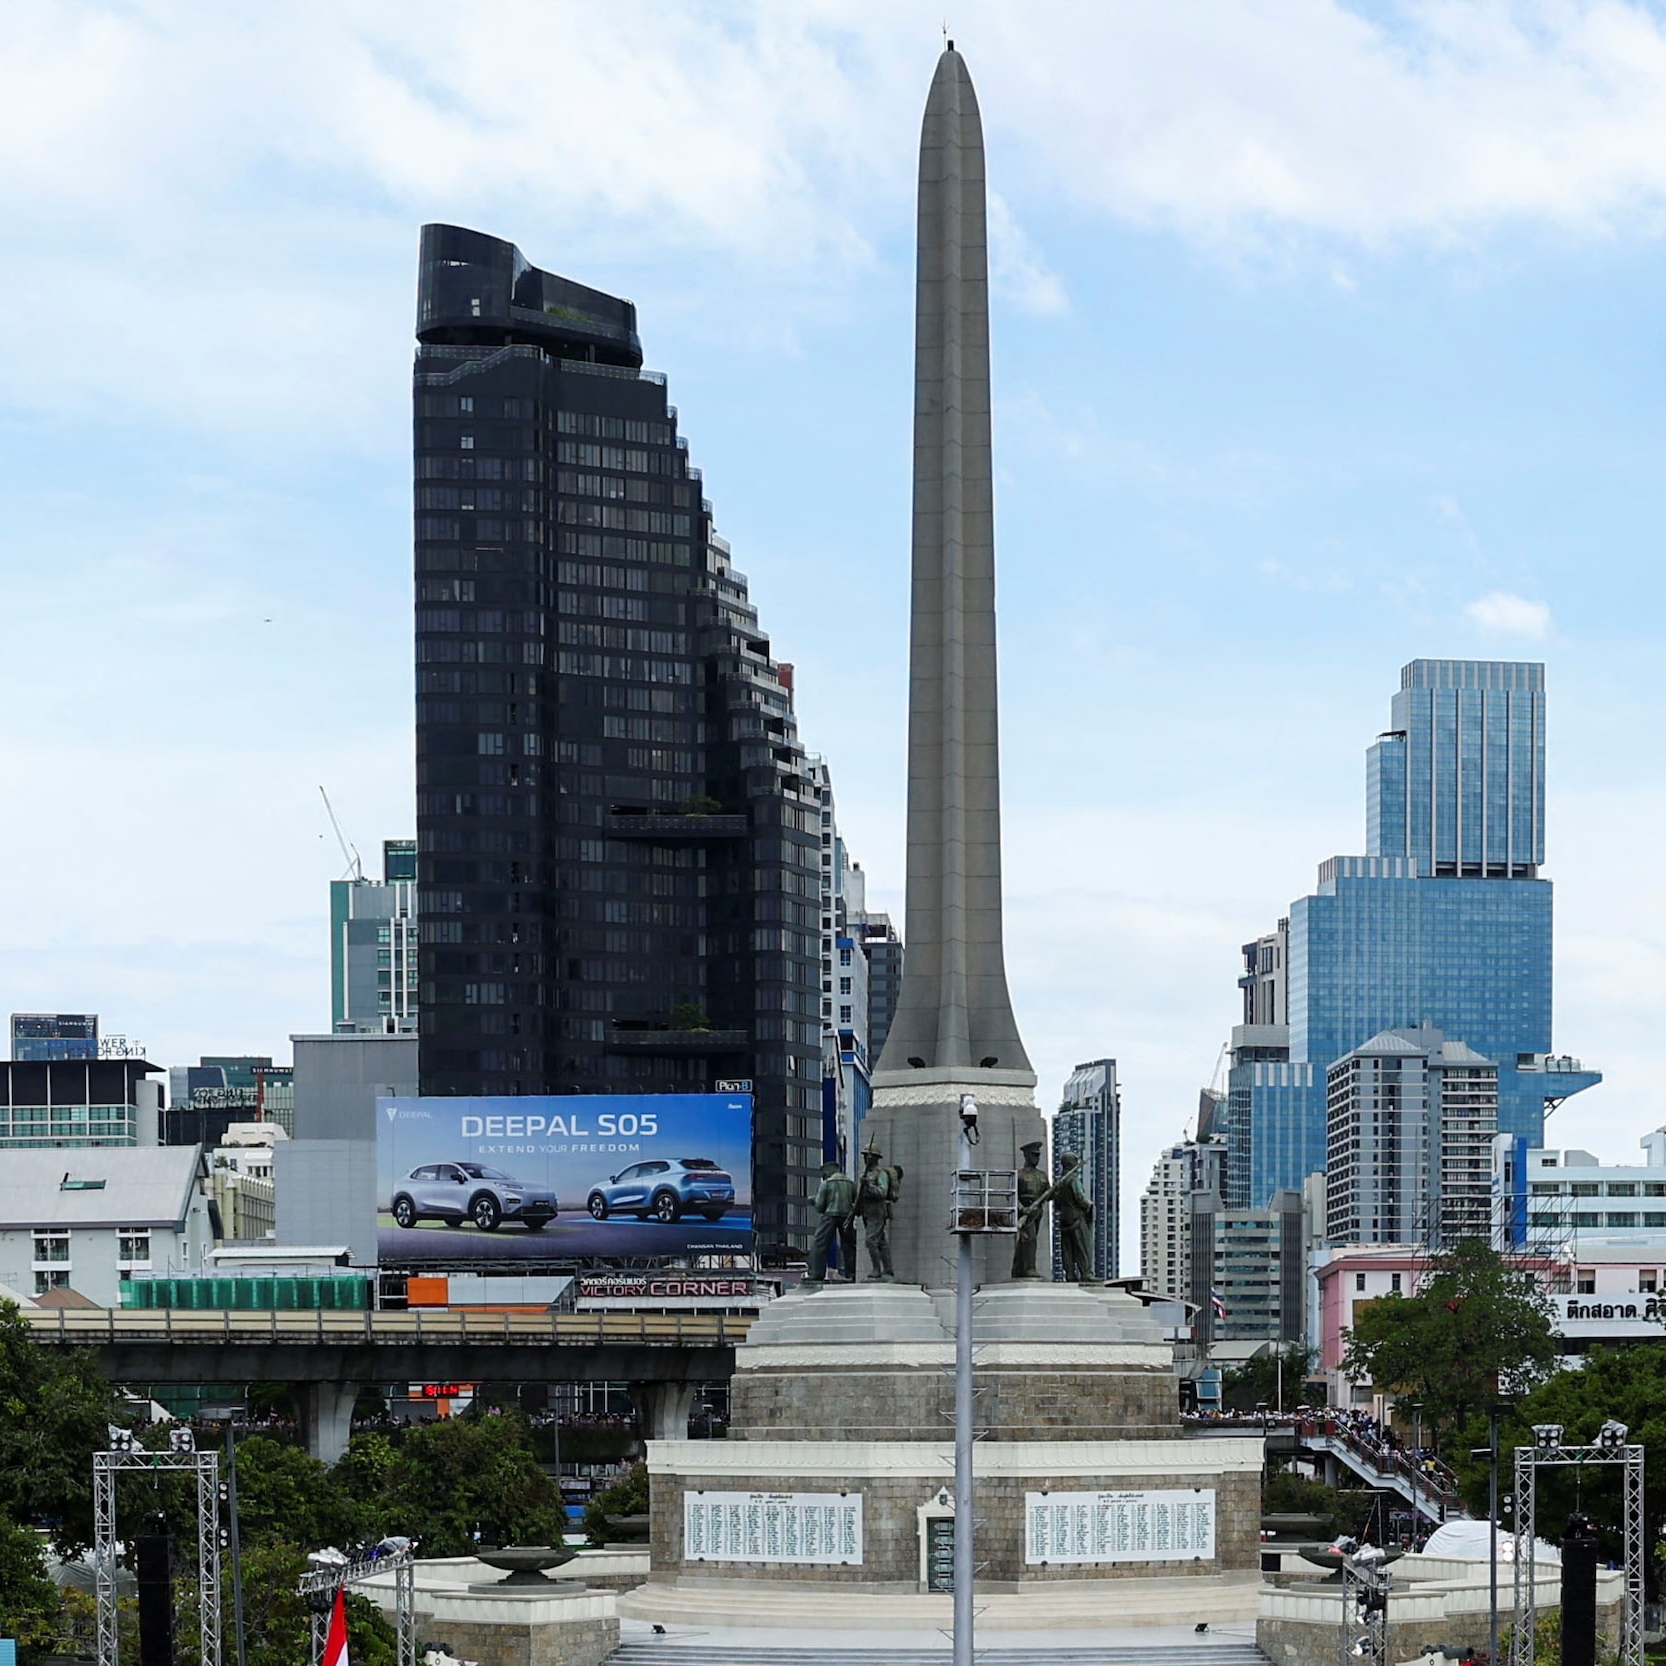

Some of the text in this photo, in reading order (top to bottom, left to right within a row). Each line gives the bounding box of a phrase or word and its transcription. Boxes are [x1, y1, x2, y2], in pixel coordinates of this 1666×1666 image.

[398, 1111, 433, 1120] DEEPAL
[461, 1114, 658, 1137] DEEPAL S05
[478, 1143, 640, 1154] EXTEND YOUR FREEDOM
[581, 1282, 747, 1296] VICTORY CORNER
